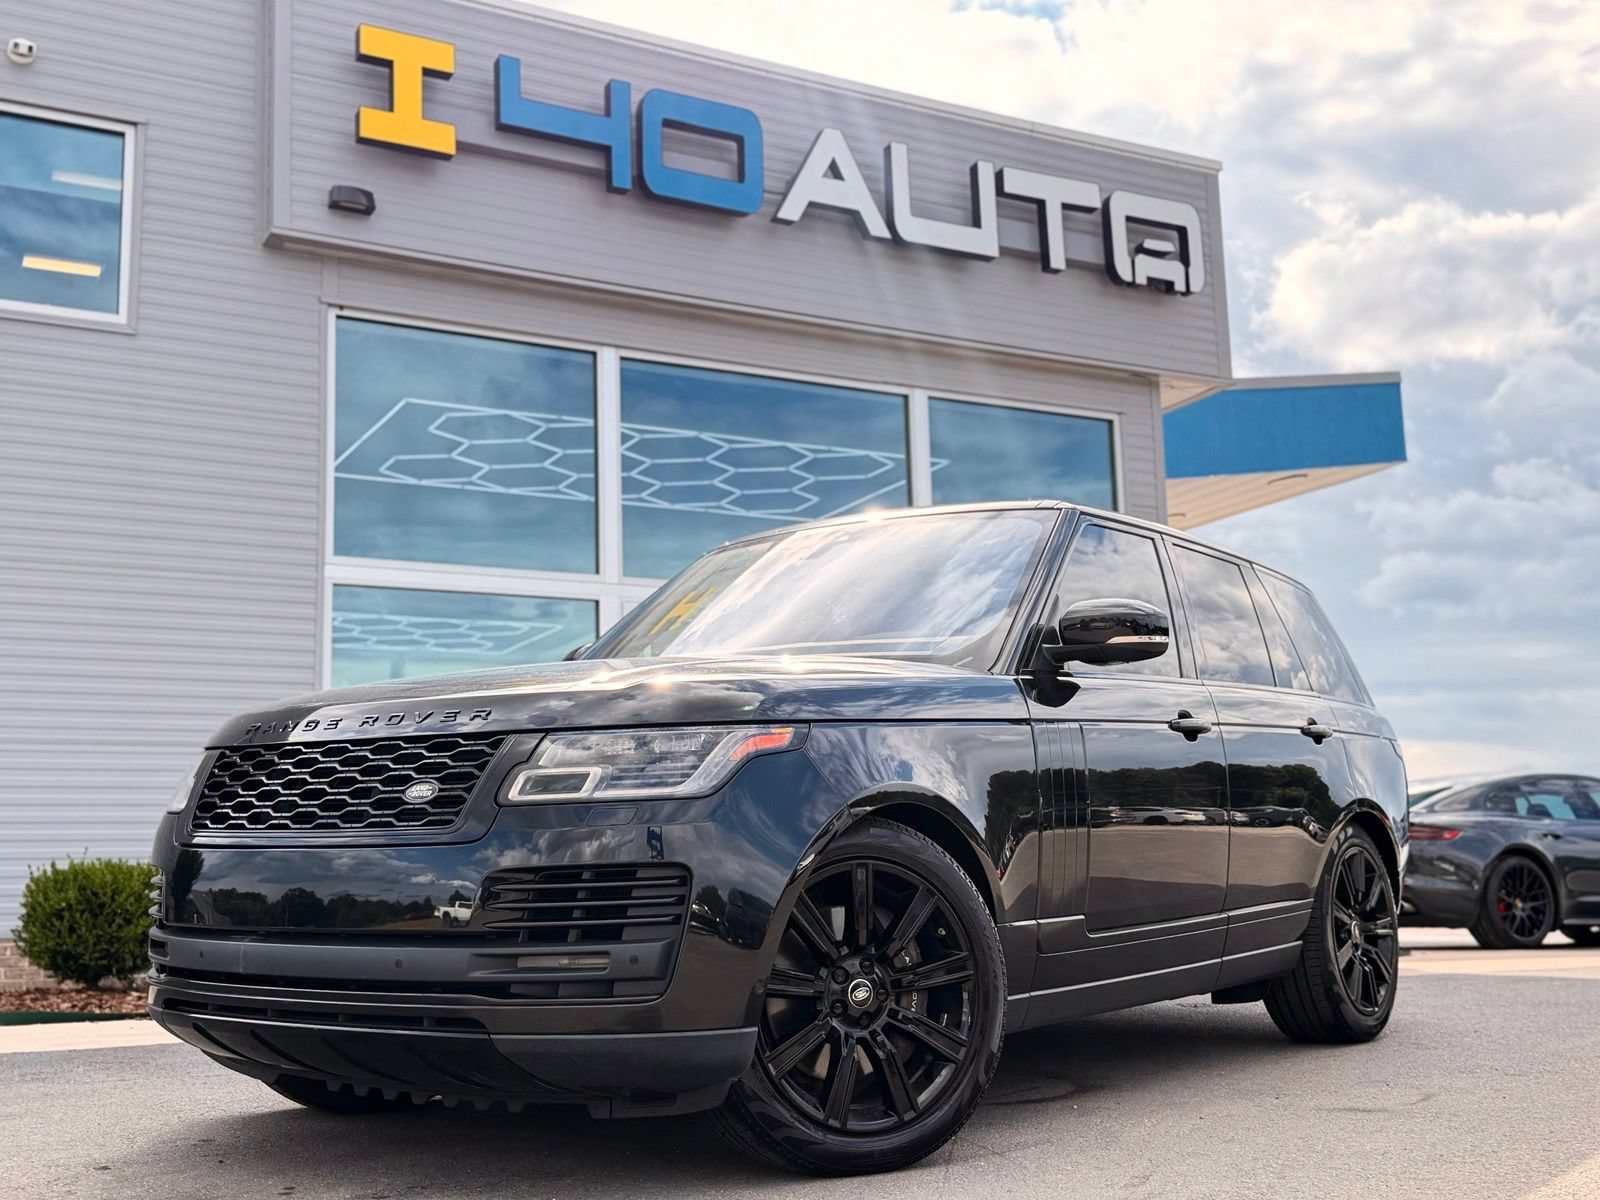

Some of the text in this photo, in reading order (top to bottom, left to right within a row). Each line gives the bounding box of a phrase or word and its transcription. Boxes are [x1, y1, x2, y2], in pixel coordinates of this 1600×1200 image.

[356, 24, 456, 157] I
[494, 54, 764, 215] 40
[245, 706, 494, 736] RANGE ROVER
